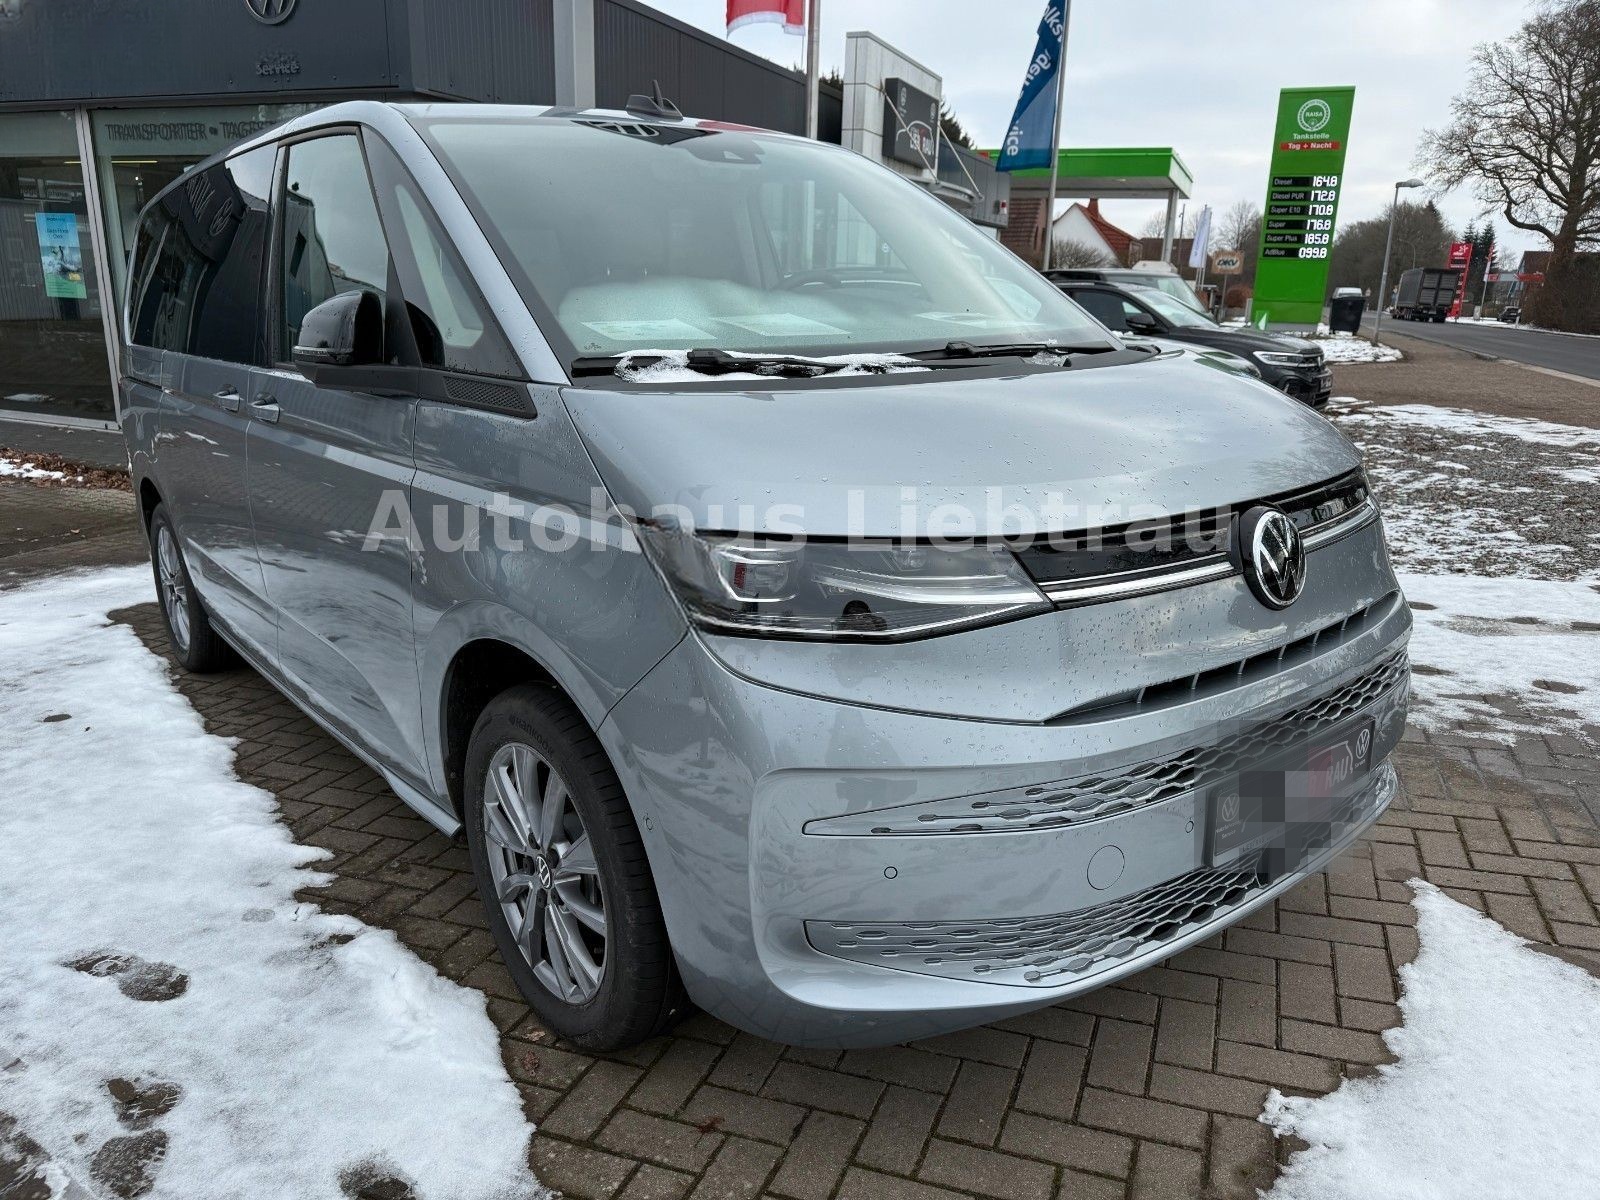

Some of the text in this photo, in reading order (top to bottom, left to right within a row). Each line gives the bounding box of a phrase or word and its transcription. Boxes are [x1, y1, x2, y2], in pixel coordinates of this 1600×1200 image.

[1271, 206, 1287, 214] Super
[1289, 206, 1301, 214] E10
[1267, 235, 1283, 243] Super
[1284, 234, 1298, 242] Plus
[1216, 258, 1238, 266] DKV
